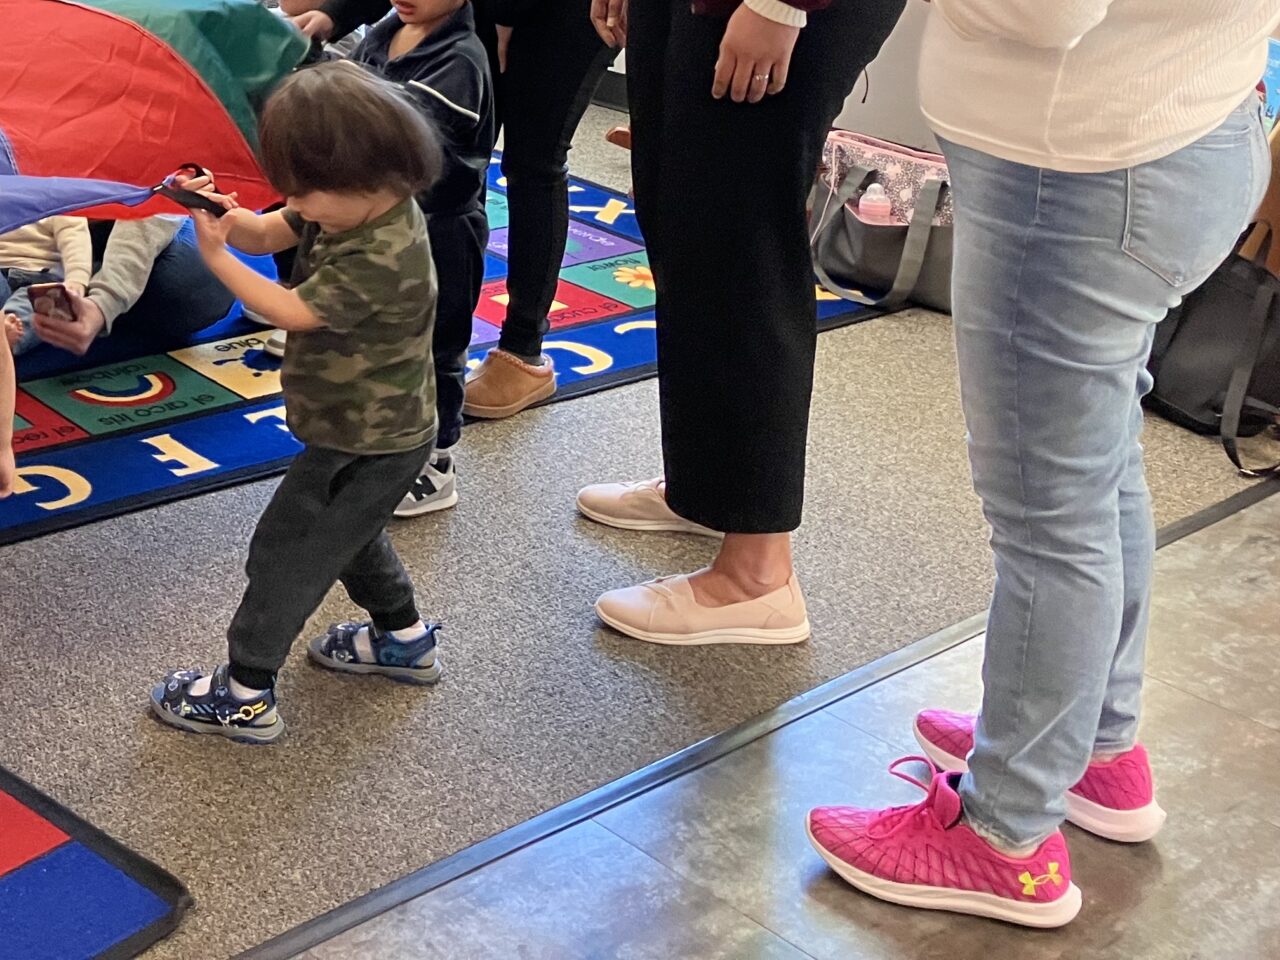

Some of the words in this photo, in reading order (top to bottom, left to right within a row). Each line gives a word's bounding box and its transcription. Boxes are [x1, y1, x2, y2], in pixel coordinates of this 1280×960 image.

[214, 338, 265, 352] blue
[192, 393, 215, 406] el
[142, 433, 222, 477] F
[12, 465, 92, 510] G
